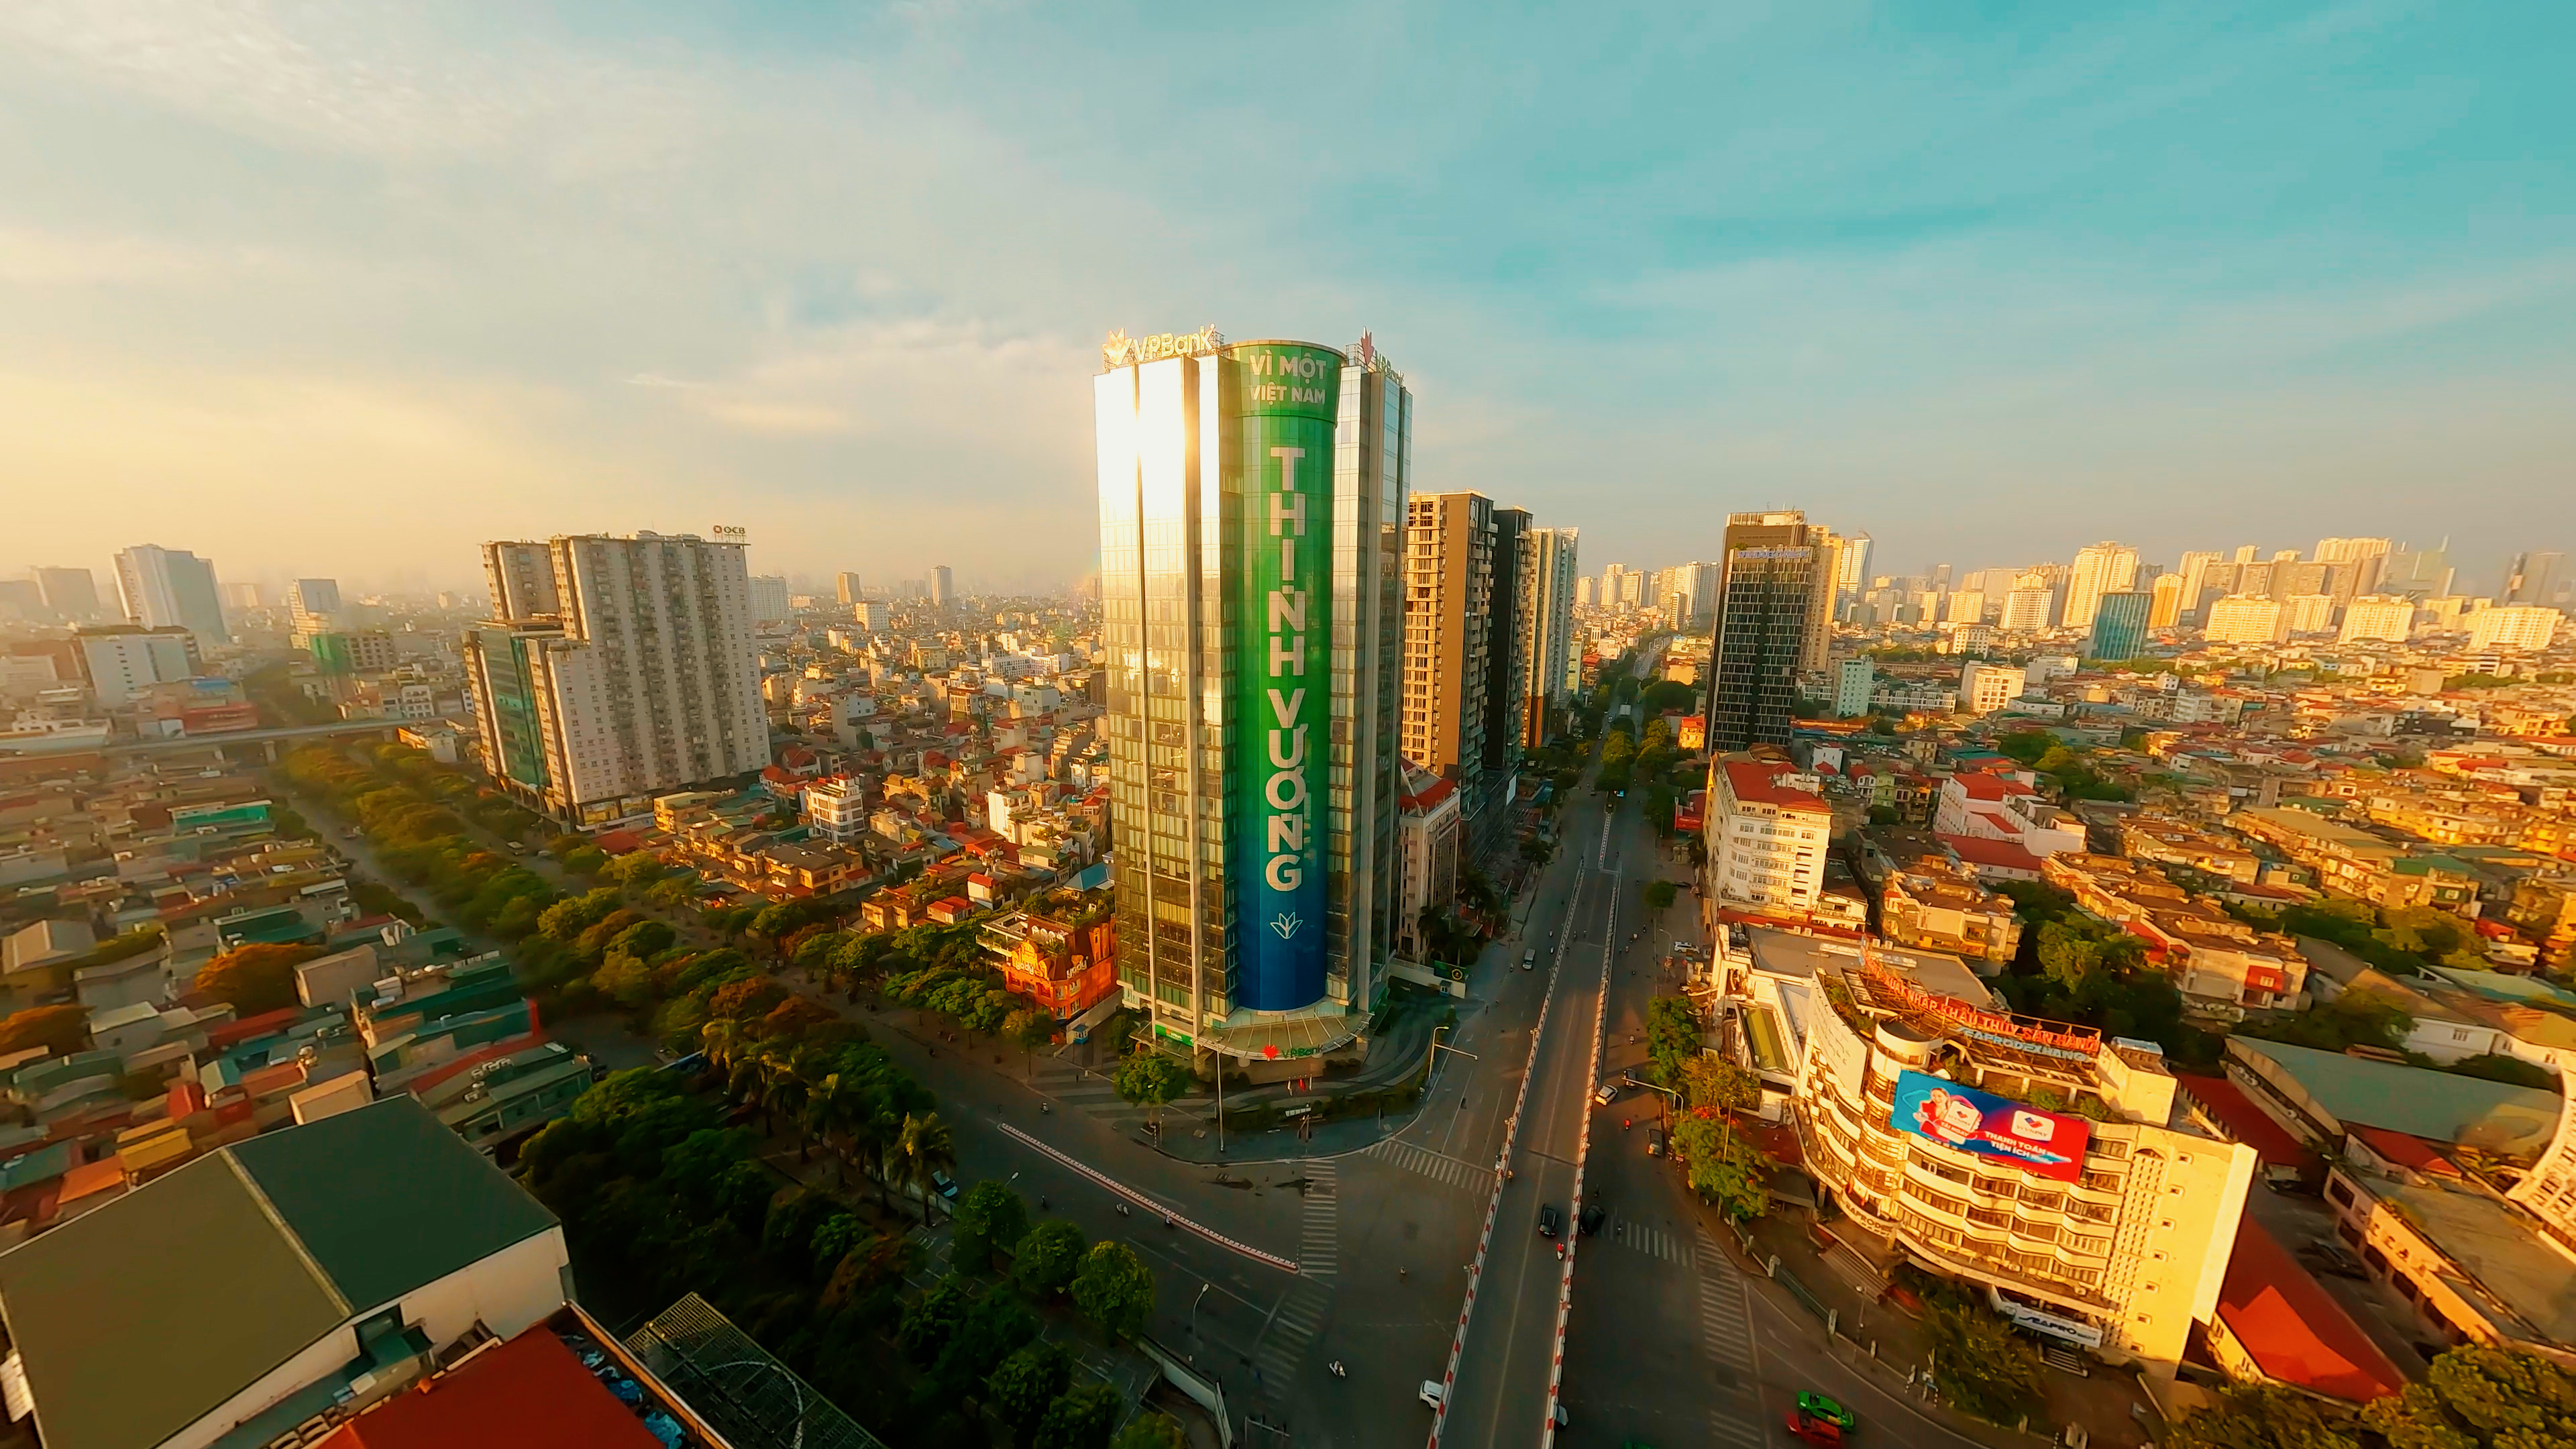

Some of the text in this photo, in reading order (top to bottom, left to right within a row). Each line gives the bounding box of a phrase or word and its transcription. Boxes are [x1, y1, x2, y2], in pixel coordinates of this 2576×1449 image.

[1134, 323, 1215, 362] VPBank
[1249, 349, 1327, 384] VÌ MỘT
[1249, 381, 1326, 405] VIỆT NAM
[724, 526, 745, 534] OCB
[1269, 447, 1305, 677] THỊNH
[1985, 1131, 2046, 1155] THANH TOÁN
